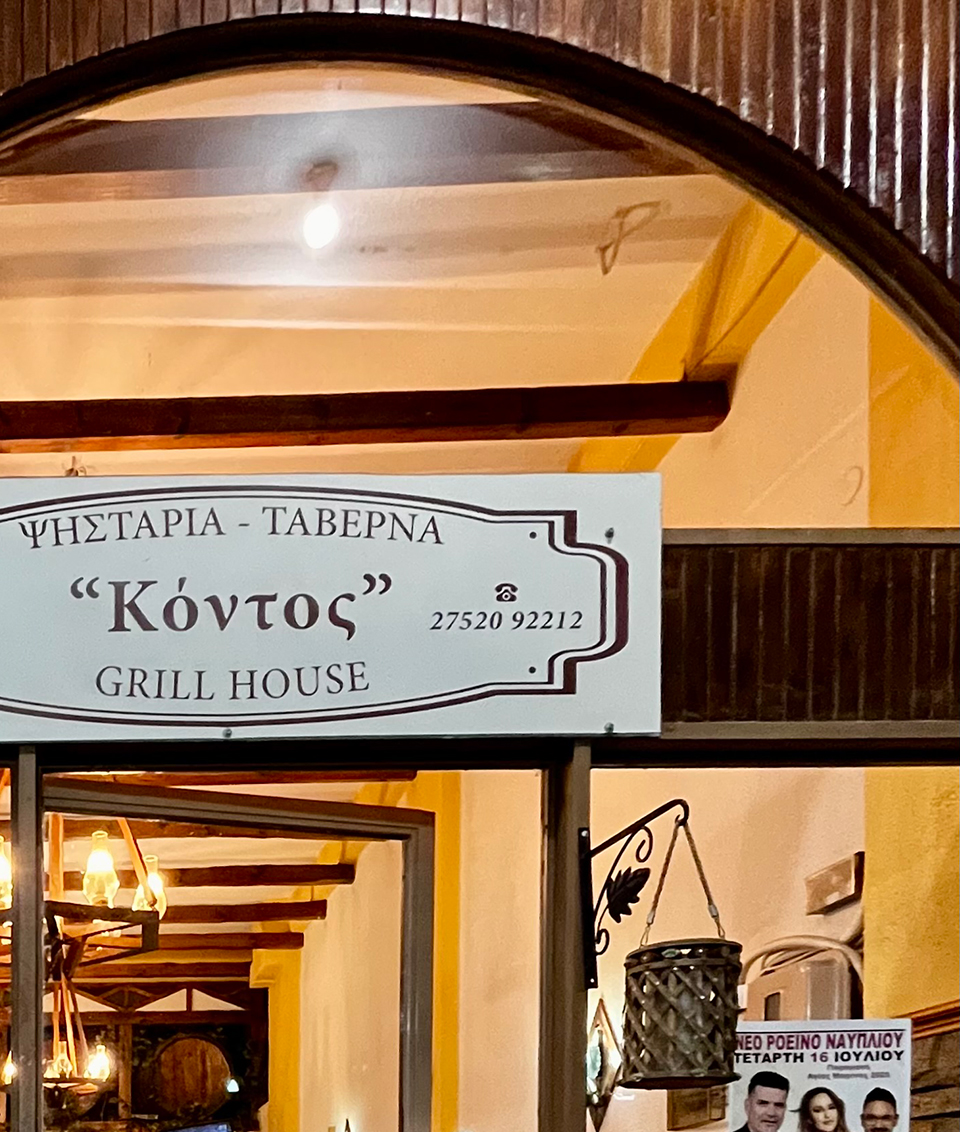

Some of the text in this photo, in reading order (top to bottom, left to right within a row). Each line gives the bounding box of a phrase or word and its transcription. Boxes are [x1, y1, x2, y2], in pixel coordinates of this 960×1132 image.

[18, 507, 226, 549] ΨΗΣΤΑΡΙΑ
[262, 506, 444, 545] ΤΑΒΕΡΝΑ
[429, 611, 583, 630] 27520 92212
[96, 661, 370, 700] GRILL HOUSE
[737, 1032, 903, 1050] ΝΕΟ ΡΟΕΙΝΟ ΝΑΥΠΛΙΟΥ
[734, 1050, 904, 1064] ΤΕΤΑΡΤΗ 16 ΙΟΥΛΙΟΥ
